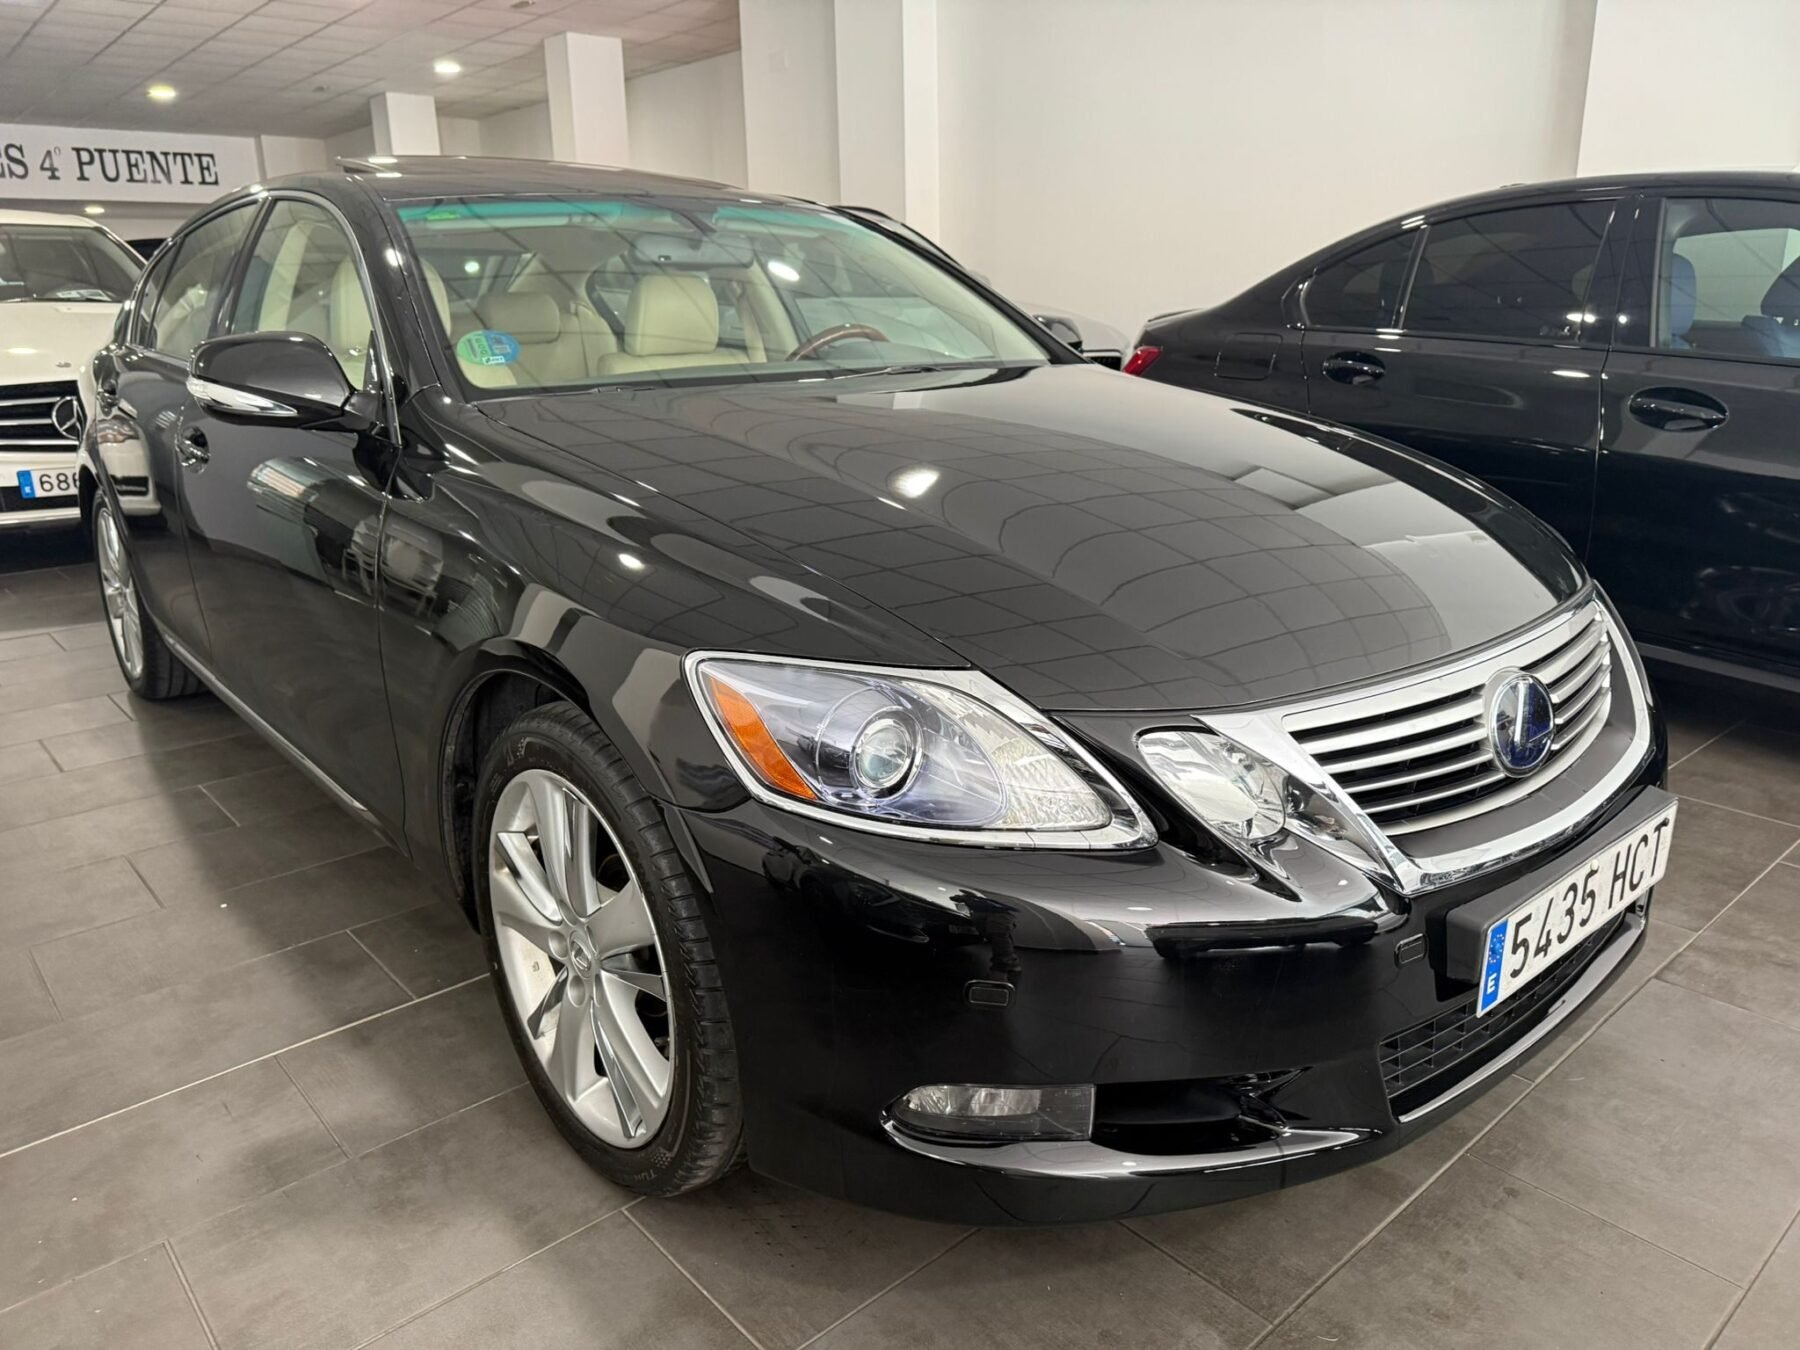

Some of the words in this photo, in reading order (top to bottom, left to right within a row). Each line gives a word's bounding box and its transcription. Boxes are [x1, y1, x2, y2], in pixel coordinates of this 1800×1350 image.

[71, 147, 219, 186] PUENTE
[1486, 973, 1497, 995] E
[1510, 869, 1599, 979] 5435
[1607, 818, 1670, 911] HCT
